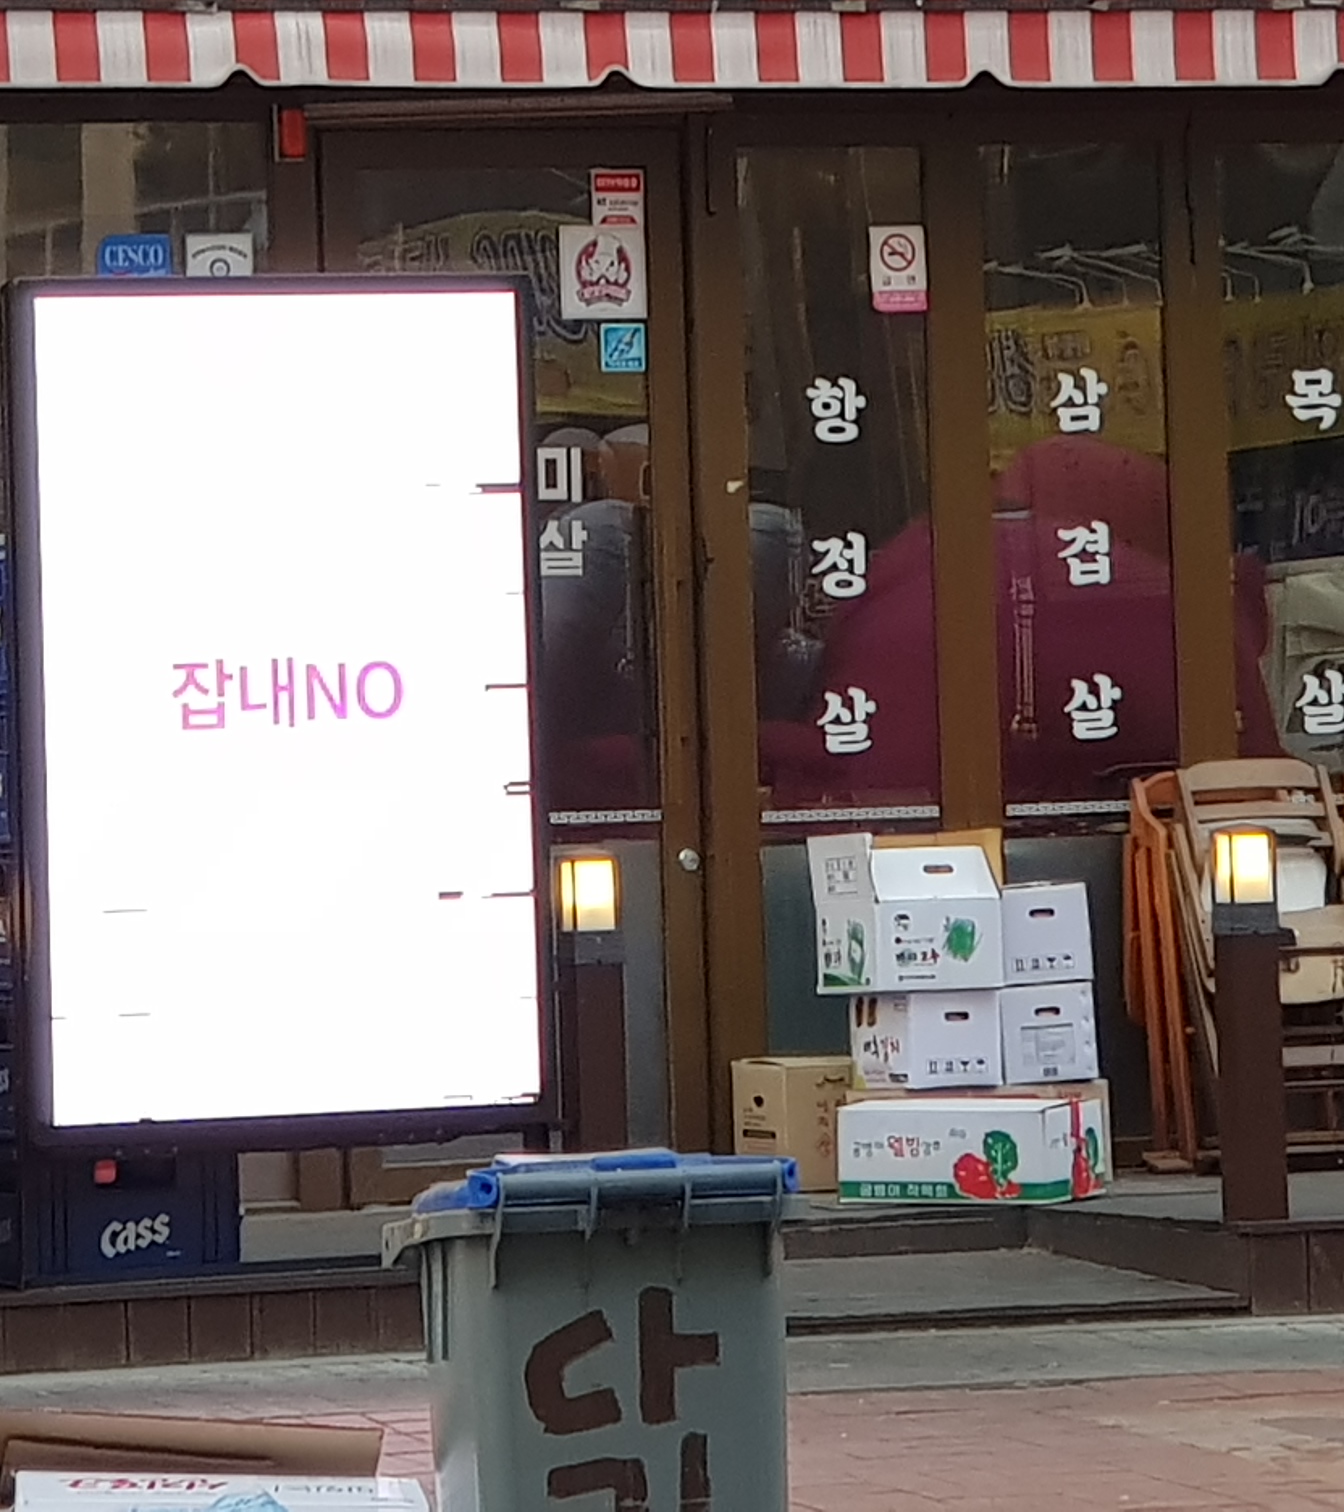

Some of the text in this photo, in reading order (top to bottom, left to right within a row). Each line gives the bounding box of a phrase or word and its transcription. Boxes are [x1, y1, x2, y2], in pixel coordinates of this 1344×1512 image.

[104, 243, 164, 268] CESCO
[805, 375, 877, 756] 항정살
[1049, 366, 1123, 743] 삼겹살
[171, 656, 404, 731] 잡내NO
[100, 1212, 171, 1259] Cass
